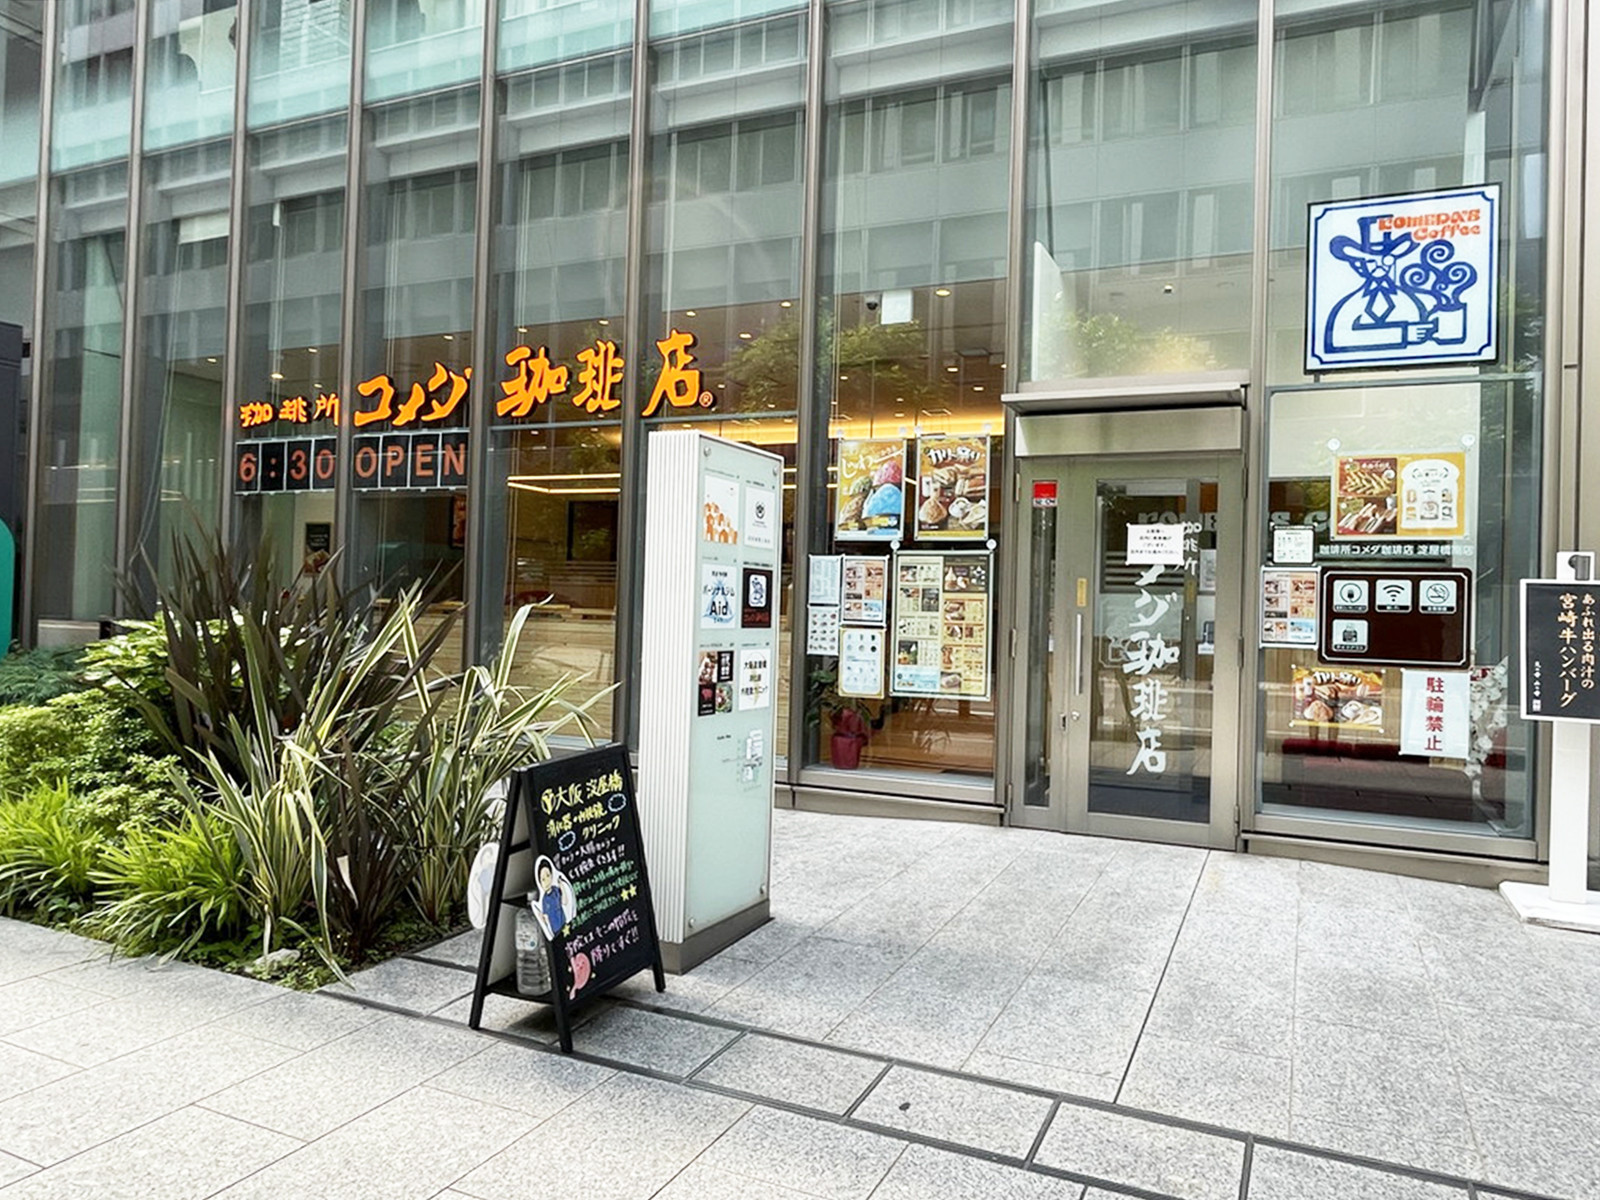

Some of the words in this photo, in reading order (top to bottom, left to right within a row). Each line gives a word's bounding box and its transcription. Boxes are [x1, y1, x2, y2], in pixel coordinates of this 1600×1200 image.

[1413, 224, 1481, 241] Coffee
[239, 448, 336, 482] 6:30
[355, 443, 467, 478] OPEN
[709, 600, 729, 616] Aid
[1123, 564, 1180, 775] メダ珈琲店
[1557, 592, 1579, 708] 宮崎牛ハンバーグ
[1425, 677, 1445, 752] 駐輪禁止
[582, 815, 620, 840] クリニック
